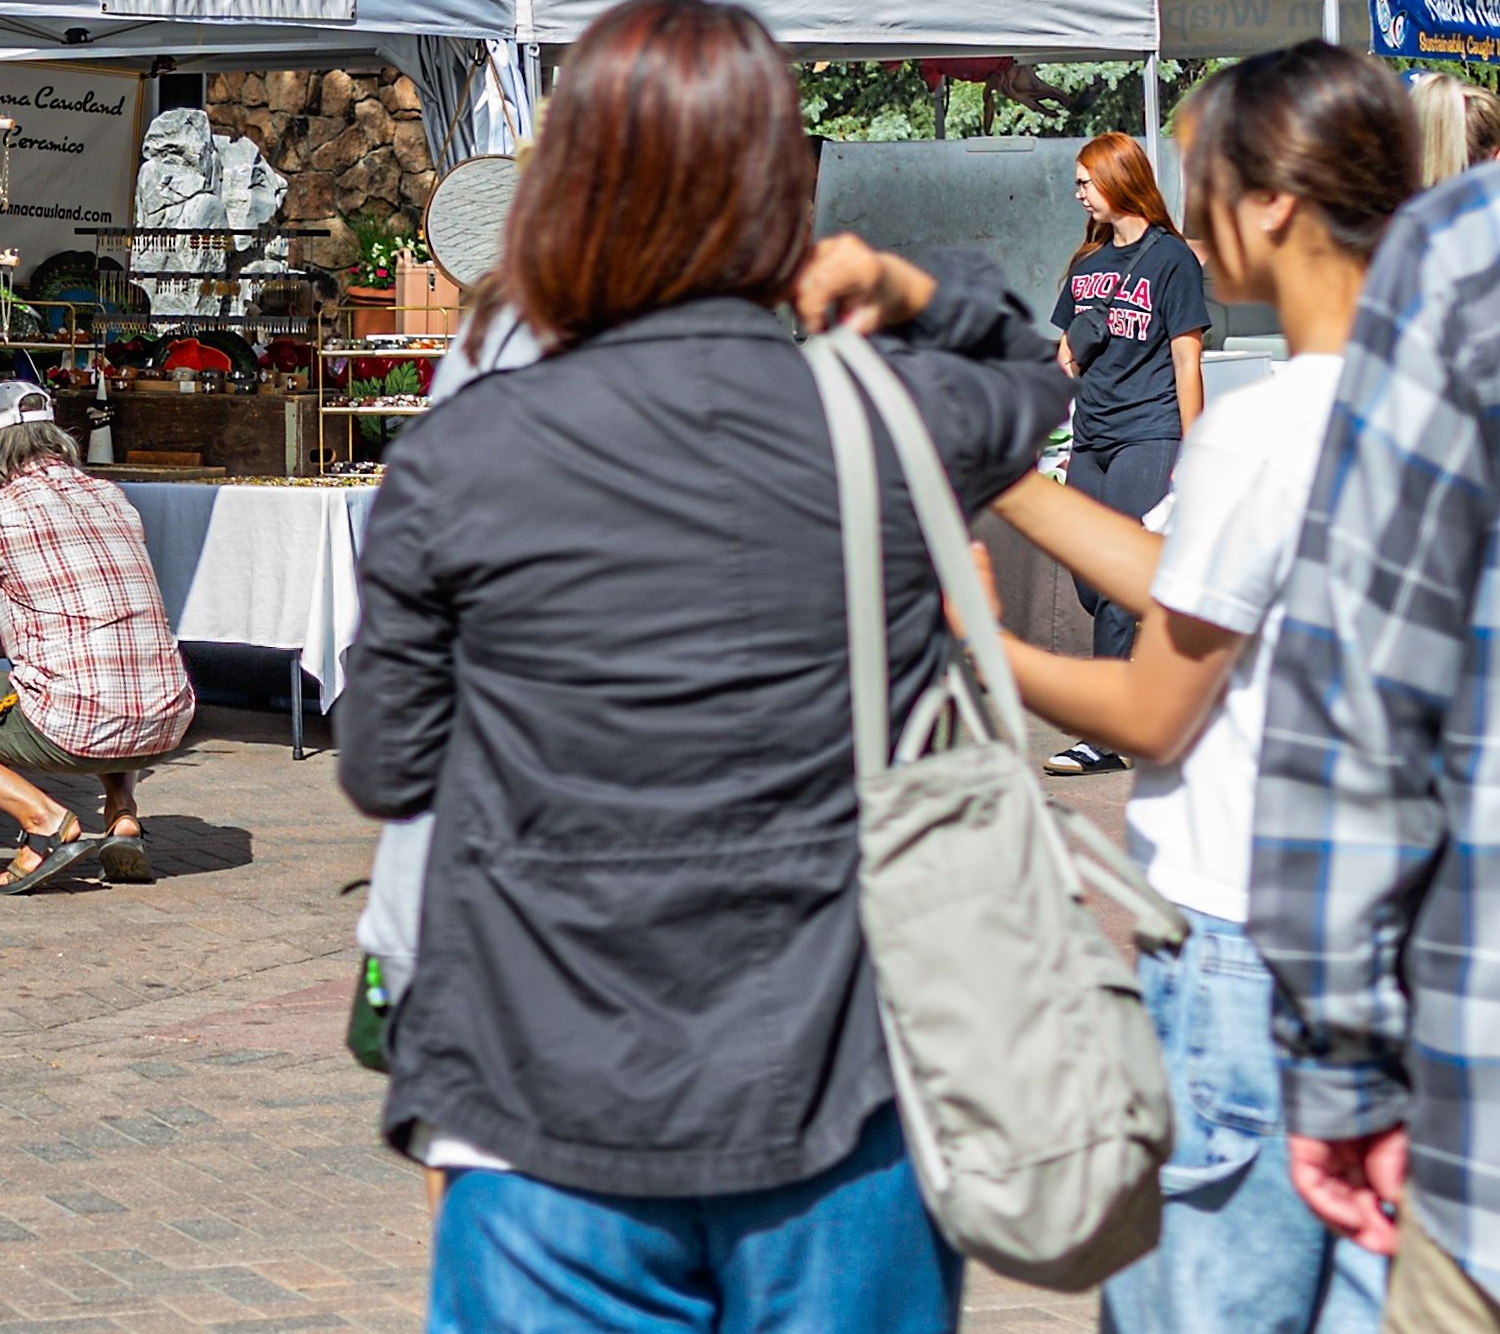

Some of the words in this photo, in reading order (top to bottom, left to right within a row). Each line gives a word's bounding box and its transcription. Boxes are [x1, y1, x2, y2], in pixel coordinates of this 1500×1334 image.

[1418, 31, 1466, 59] Sustainably
[1466, 35, 1495, 61] Caught
[34, 85, 126, 116] Causland
[2, 125, 85, 154] Ceramics
[1072, 272, 1152, 312] BIOLA
